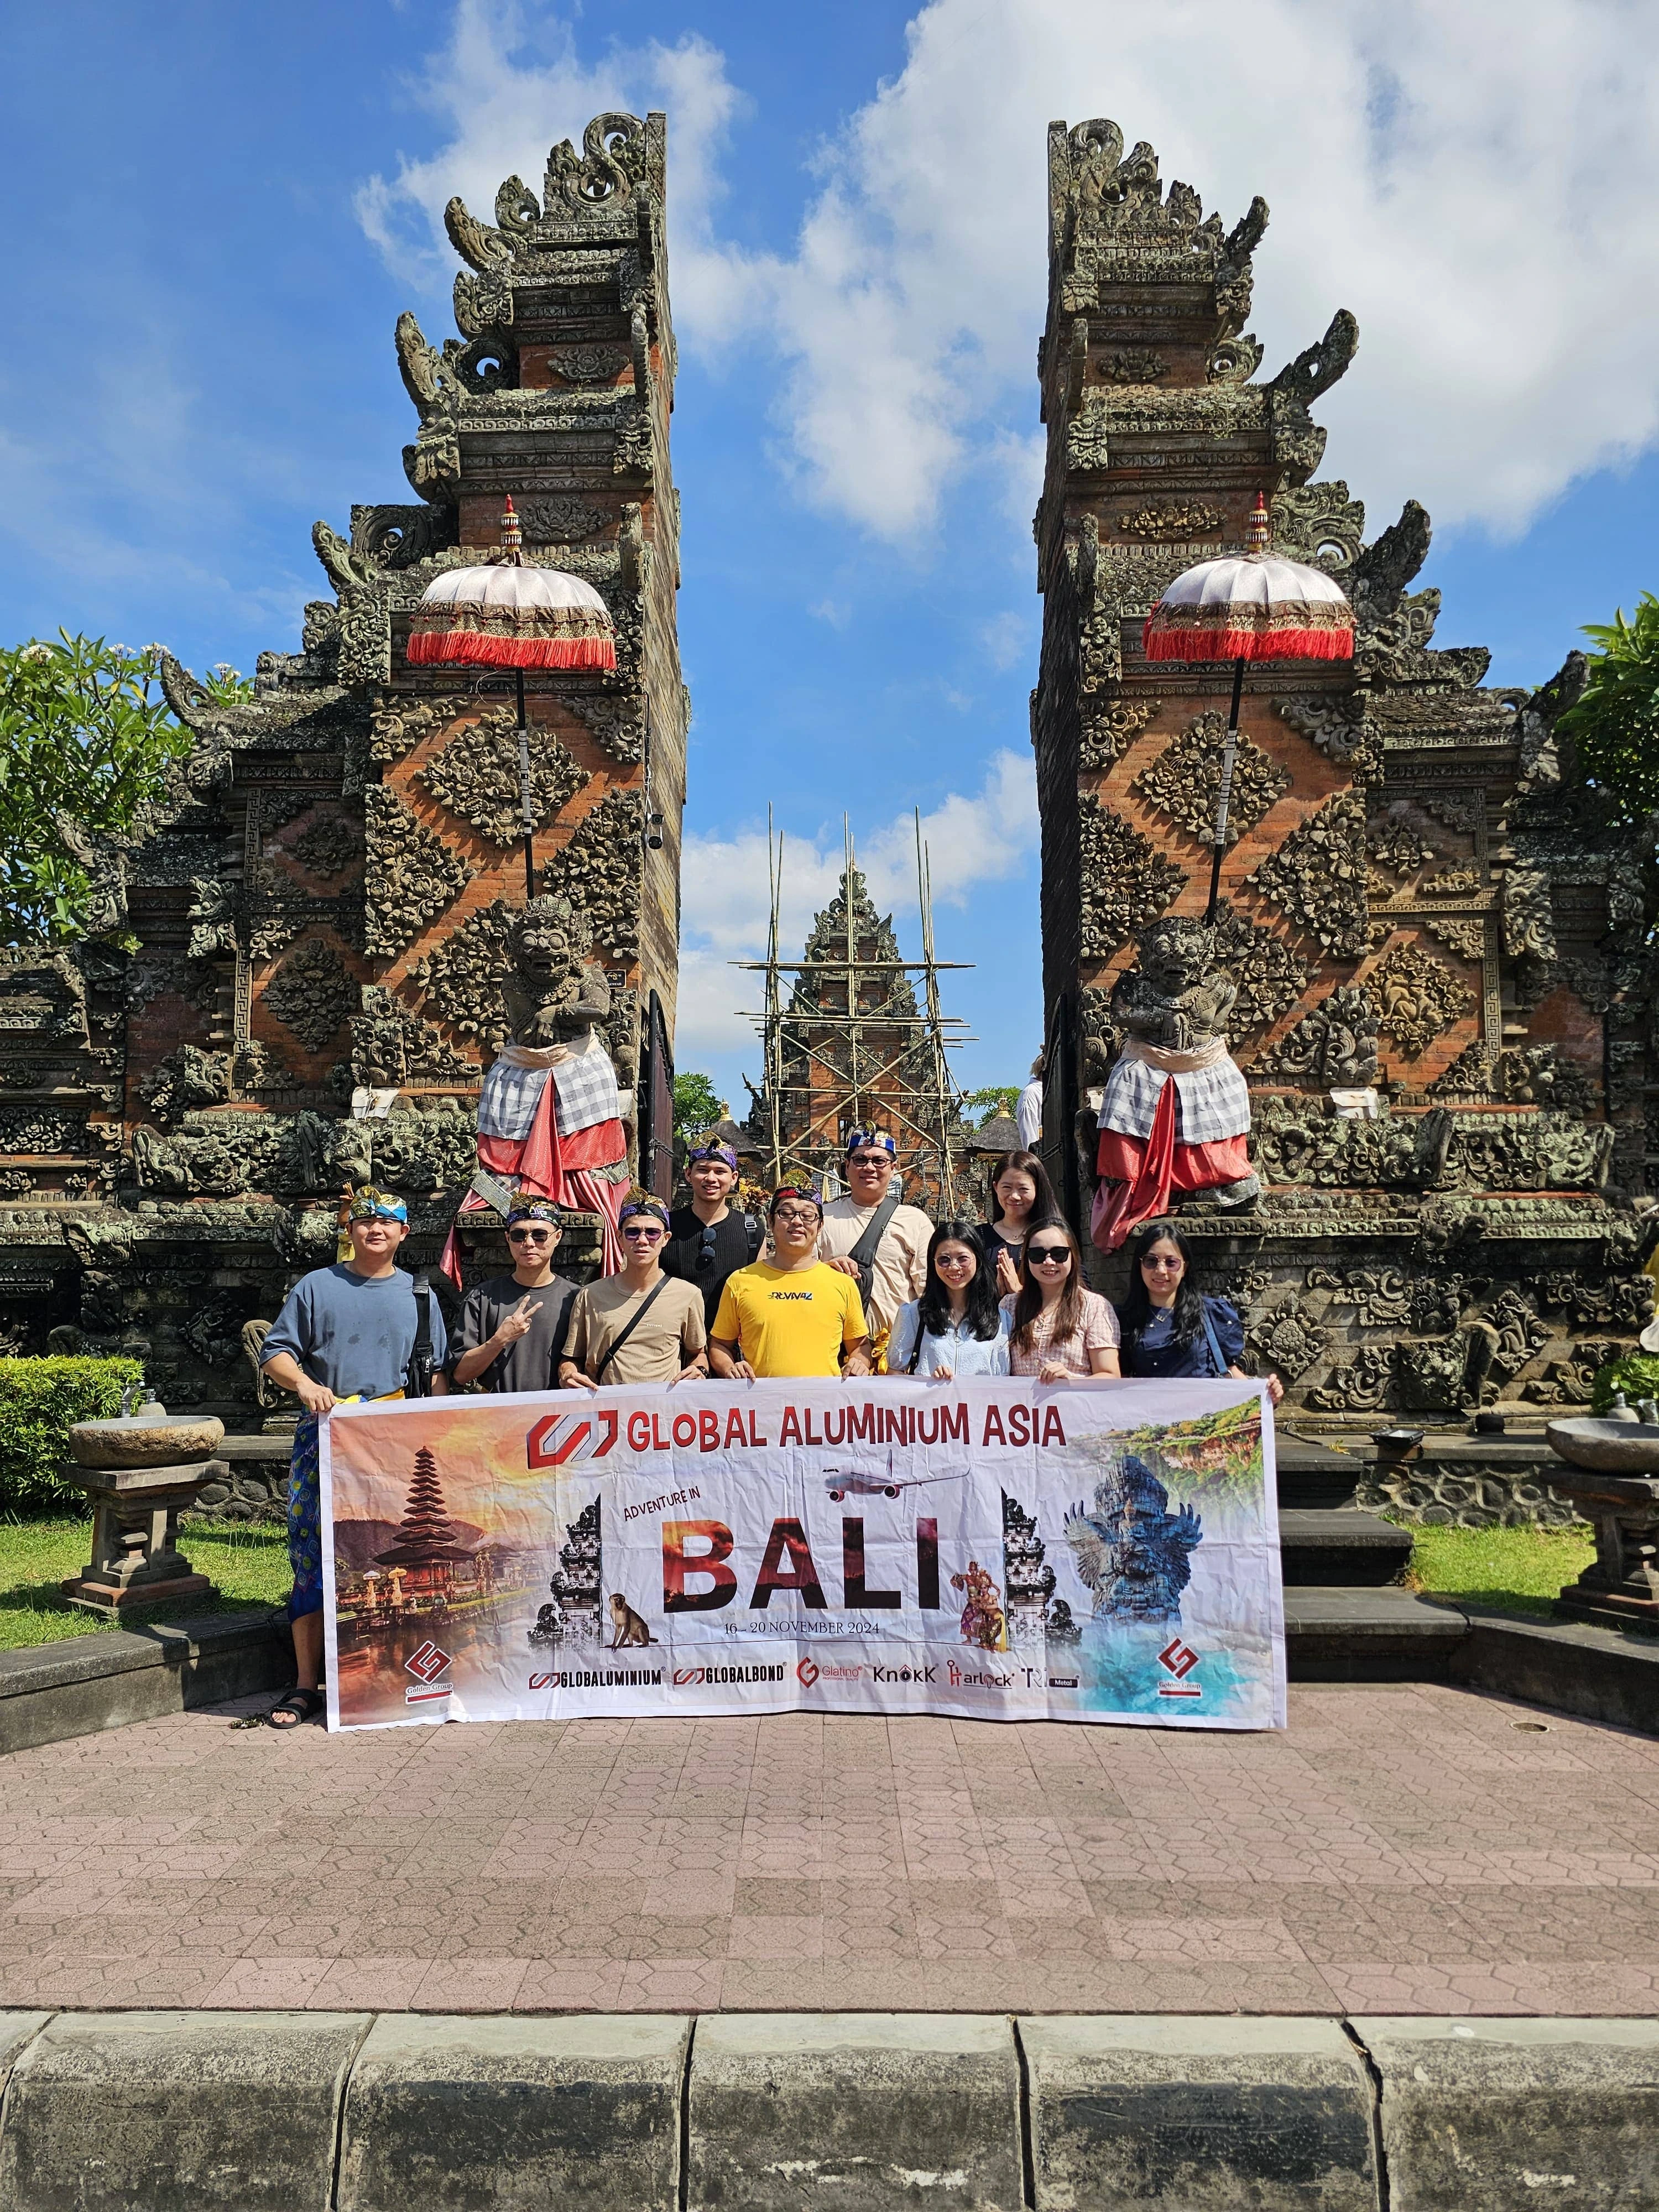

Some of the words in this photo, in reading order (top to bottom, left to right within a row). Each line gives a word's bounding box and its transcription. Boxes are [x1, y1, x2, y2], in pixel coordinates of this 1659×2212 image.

[627, 1407, 767, 1453] GLOBAL
[779, 1402, 970, 1447] ALUMINIUM
[982, 1404, 1066, 1447] ASIA
[624, 1490, 687, 1522] ADVENTURE
[688, 1485, 701, 1500] IN
[662, 1517, 940, 1614] BALI
[724, 1623, 737, 1634] 16
[750, 1622, 766, 1633] 20
[769, 1621, 844, 1634] NOVEMBER
[847, 1622, 879, 1634] 2024
